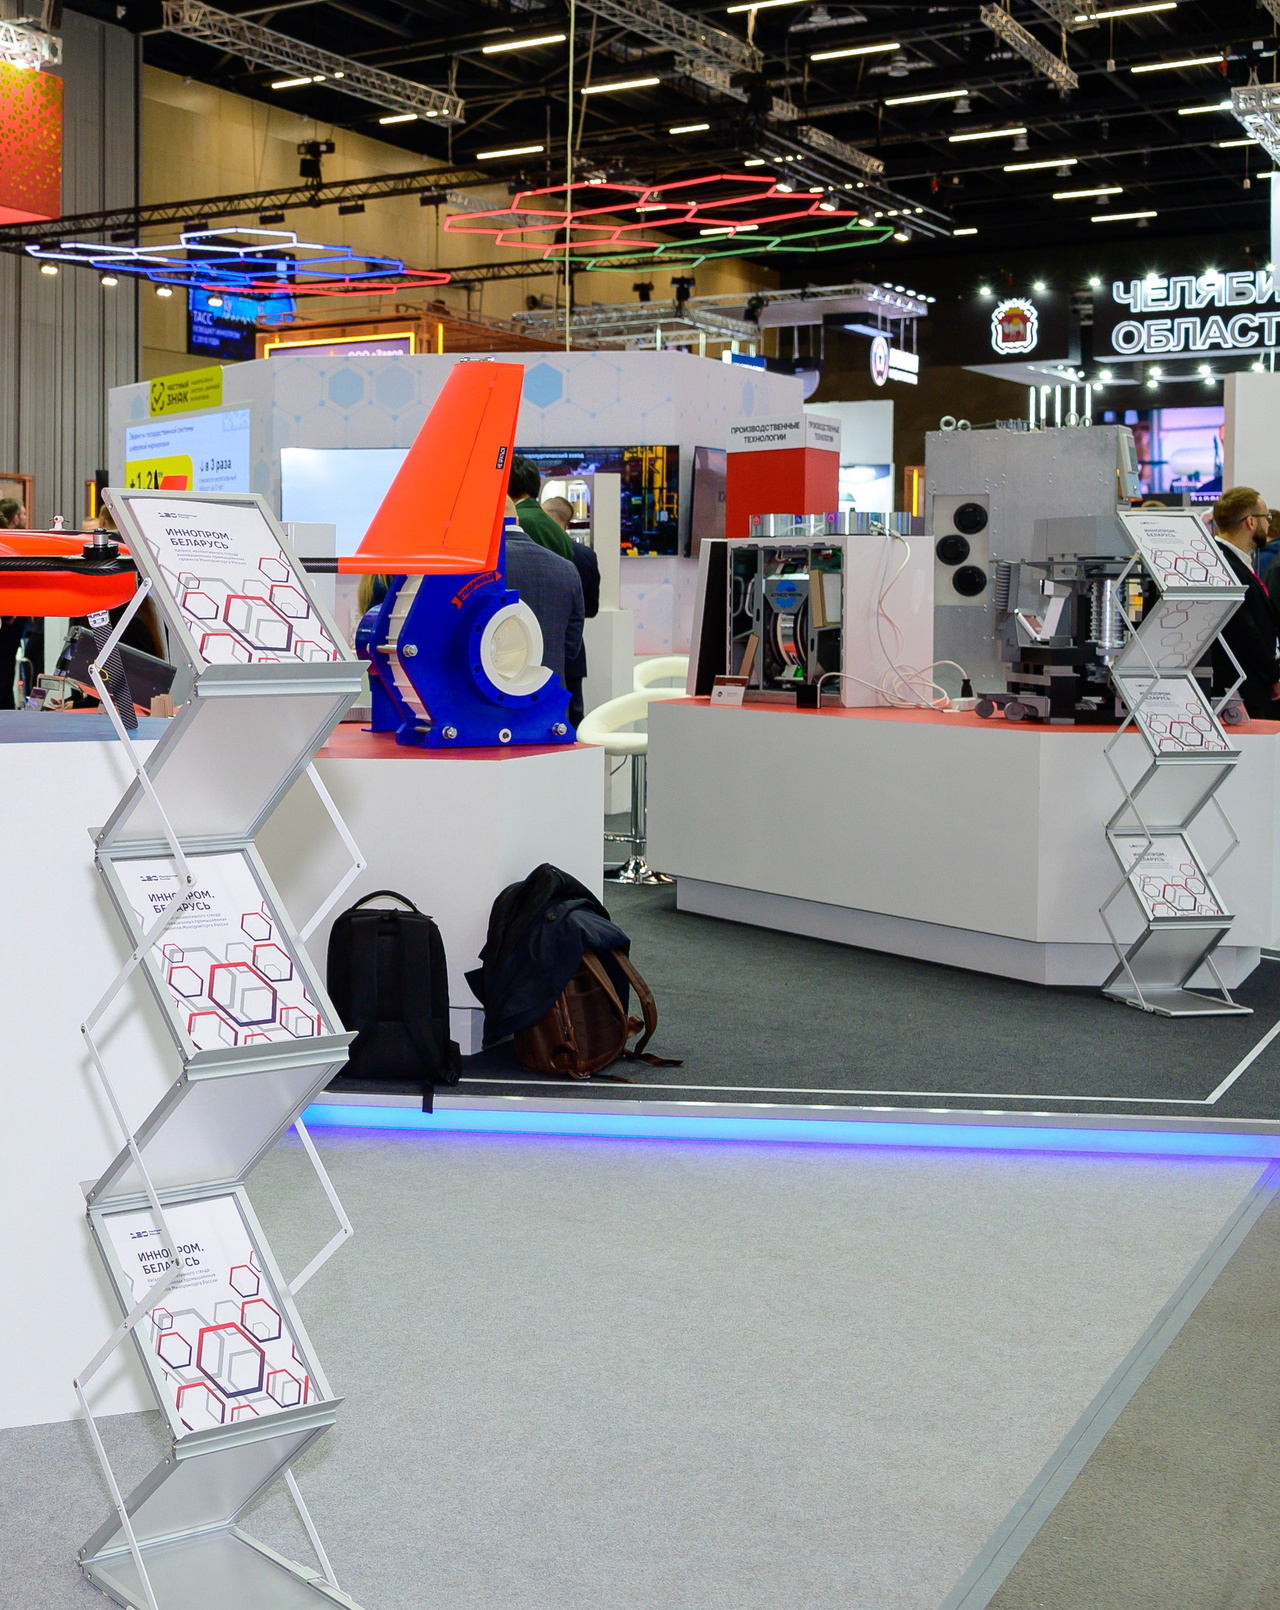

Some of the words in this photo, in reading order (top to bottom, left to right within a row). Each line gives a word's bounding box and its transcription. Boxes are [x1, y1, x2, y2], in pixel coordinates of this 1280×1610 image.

[193, 311, 213, 325] ТАСС
[1112, 313, 1280, 354] ОБЛАСТ
[167, 392, 189, 406] ЗНАК
[731, 421, 800, 434] ПРОИЗВОДСТВЕННЫЕ
[744, 434, 786, 443] ТЕХНОЛОГИИ
[216, 460, 231, 473] раза
[165, 528, 233, 541] ИННОПРОМ.
[170, 538, 229, 550] БЕЛАРУСЬ
[148, 890, 215, 903] ИННОРОМ.
[153, 902, 211, 914] БЕАРУСЬ
[142, 1257, 200, 1275] БЕЛАСЬ
